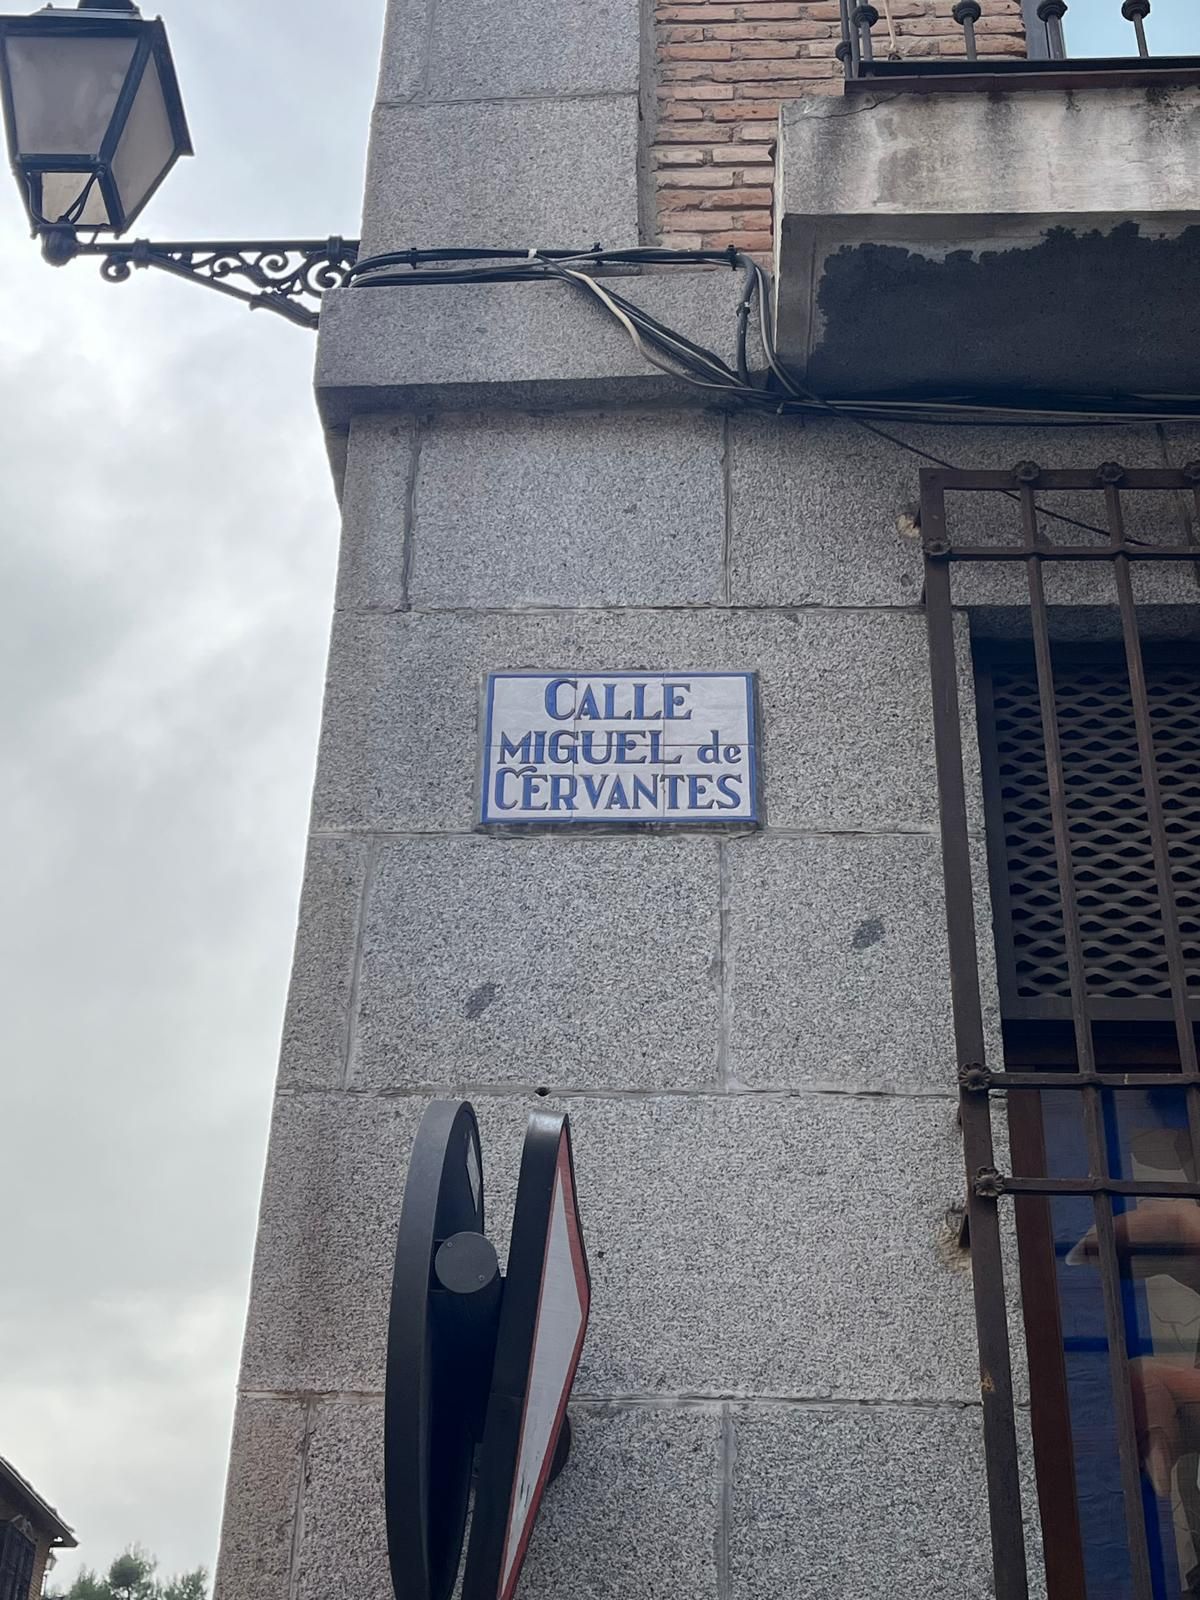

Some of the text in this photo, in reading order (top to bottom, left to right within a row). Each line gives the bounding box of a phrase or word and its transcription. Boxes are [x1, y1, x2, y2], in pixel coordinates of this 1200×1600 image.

[545, 679, 692, 720] CALLE
[497, 730, 742, 765] MIGUEL de
[494, 766, 743, 810] CERVANTES
